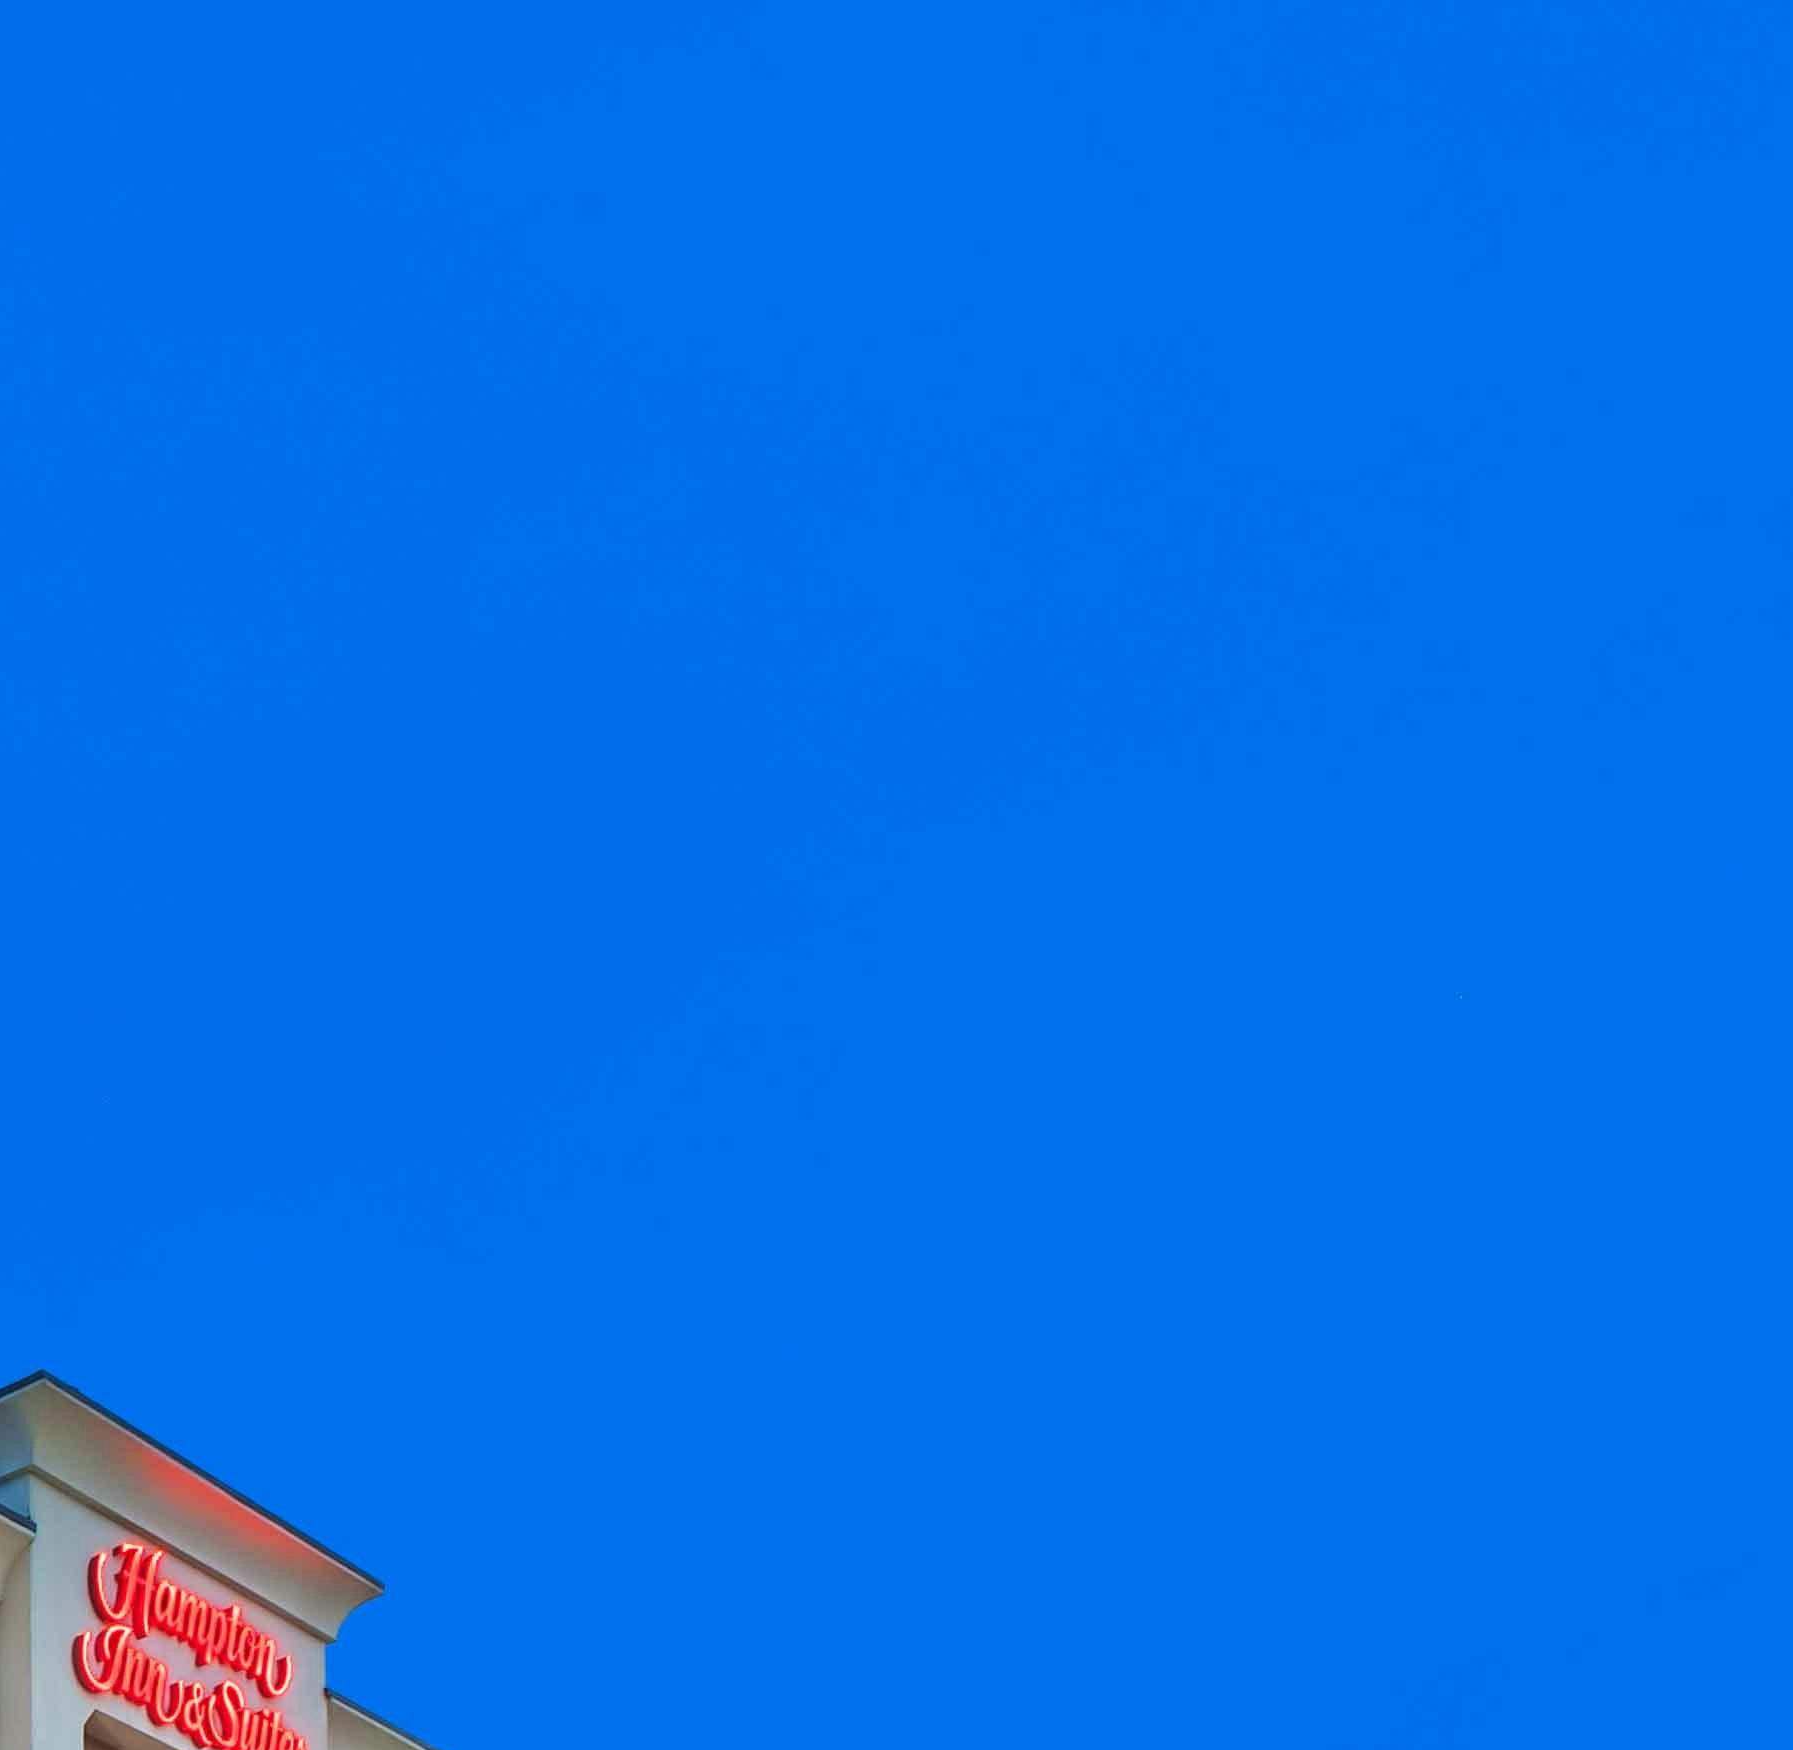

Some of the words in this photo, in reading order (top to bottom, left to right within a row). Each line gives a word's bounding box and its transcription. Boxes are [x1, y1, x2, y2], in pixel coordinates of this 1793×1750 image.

[72, 1625, 184, 1726] Inn
[182, 1682, 215, 1750] &
[88, 1543, 293, 1698] Hampton
